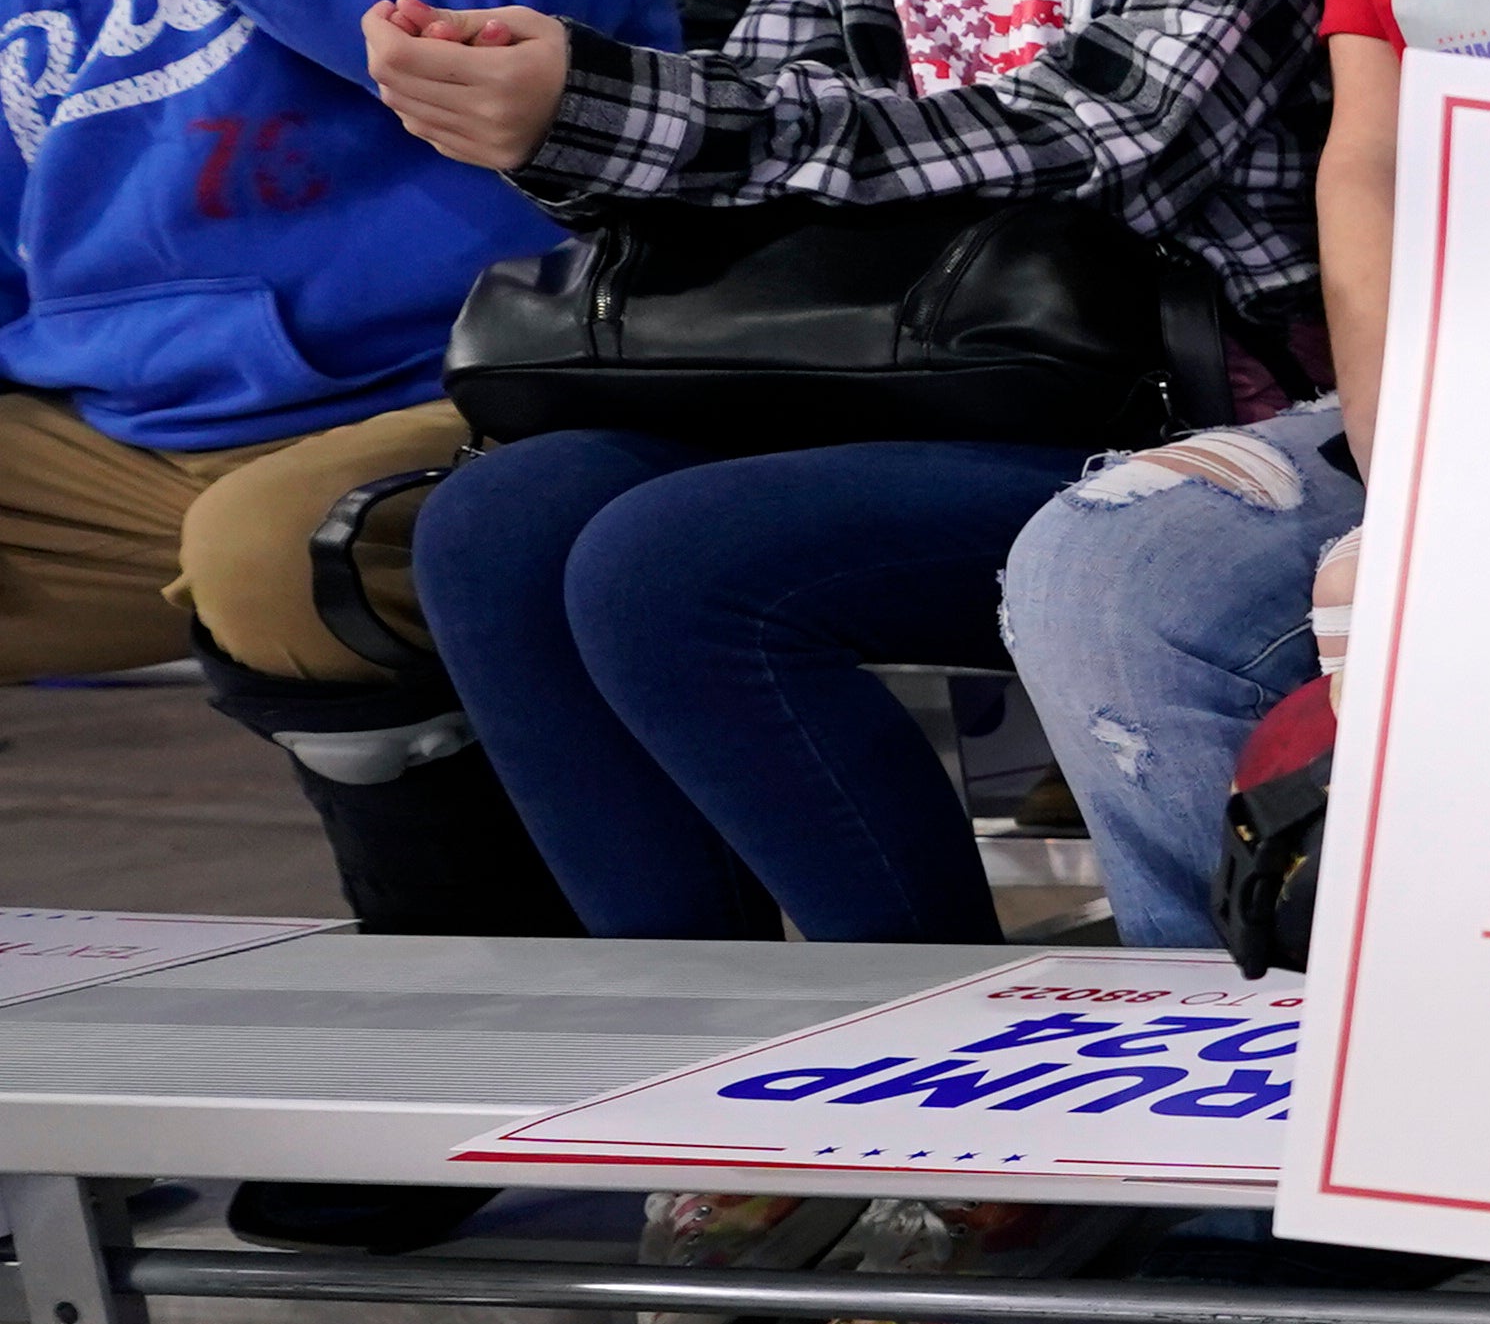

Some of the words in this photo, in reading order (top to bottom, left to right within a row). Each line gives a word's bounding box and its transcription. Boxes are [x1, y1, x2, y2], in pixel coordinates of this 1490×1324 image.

[987, 986, 1172, 1003] 88022
[1180, 992, 1257, 1006] TO
[950, 1012, 1301, 1063] 024
[717, 1057, 1293, 1121] RUMP
